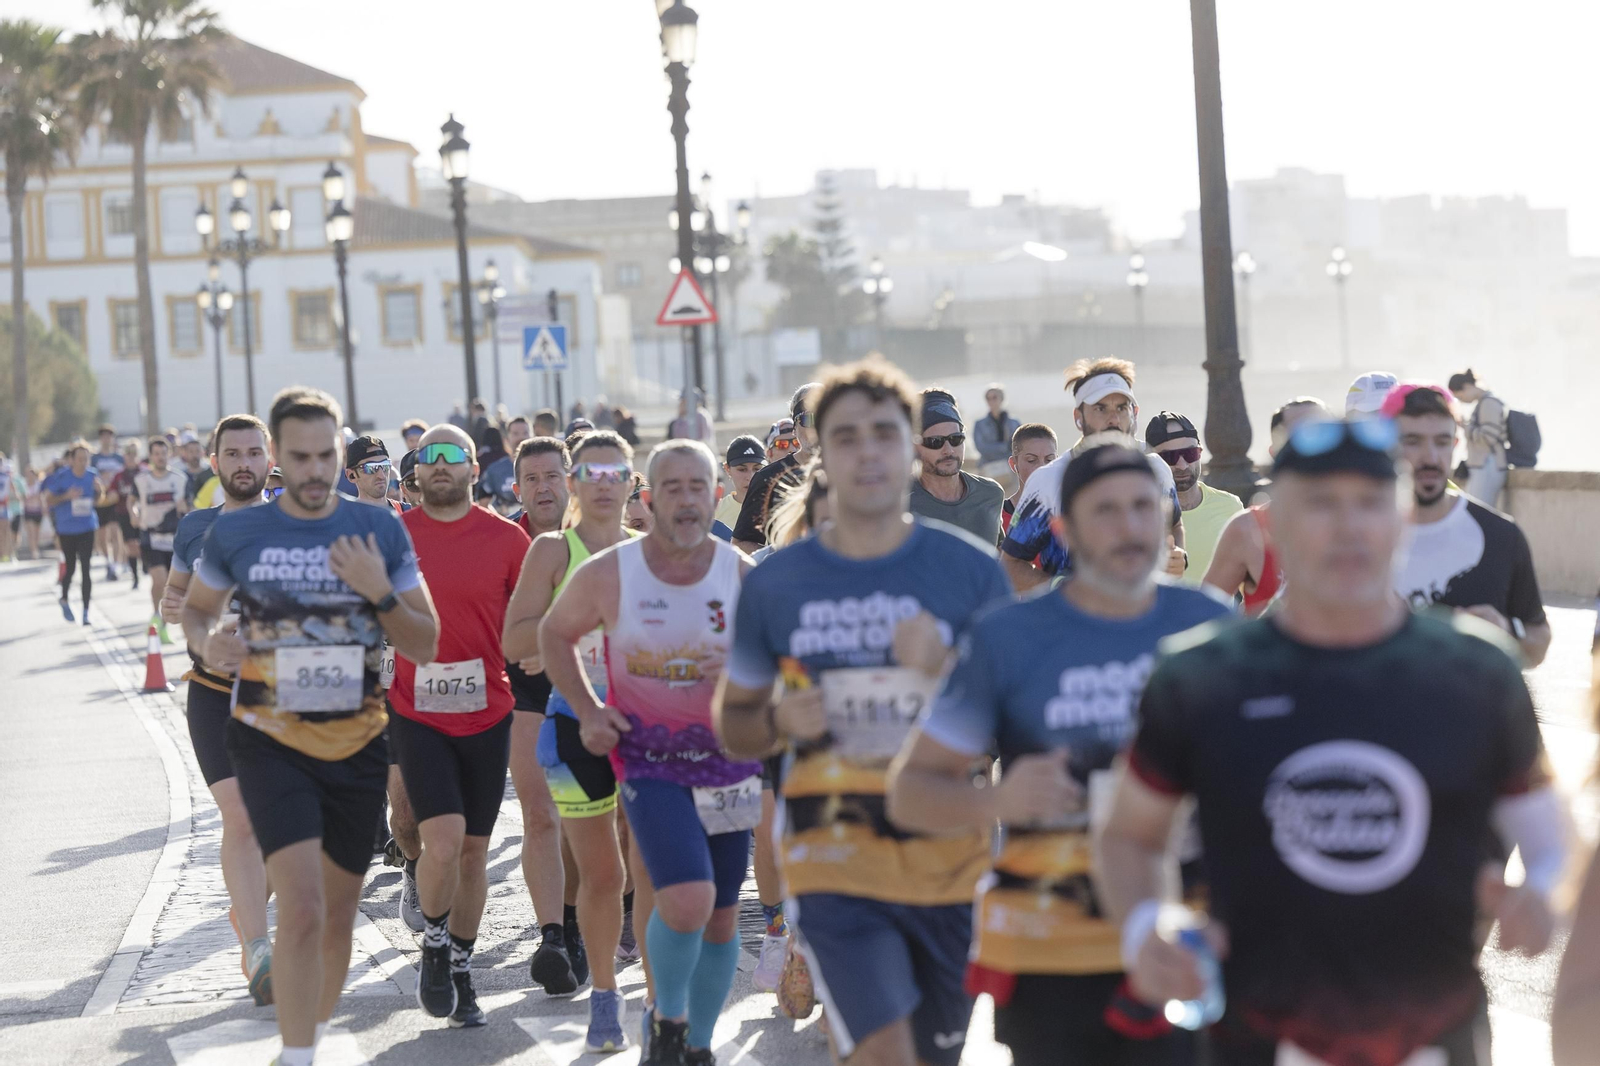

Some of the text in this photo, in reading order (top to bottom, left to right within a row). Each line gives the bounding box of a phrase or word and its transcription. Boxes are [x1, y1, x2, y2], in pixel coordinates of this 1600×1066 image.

[297, 665, 344, 690] 853
[425, 676, 477, 696] 1075
[714, 786, 752, 811] 371
